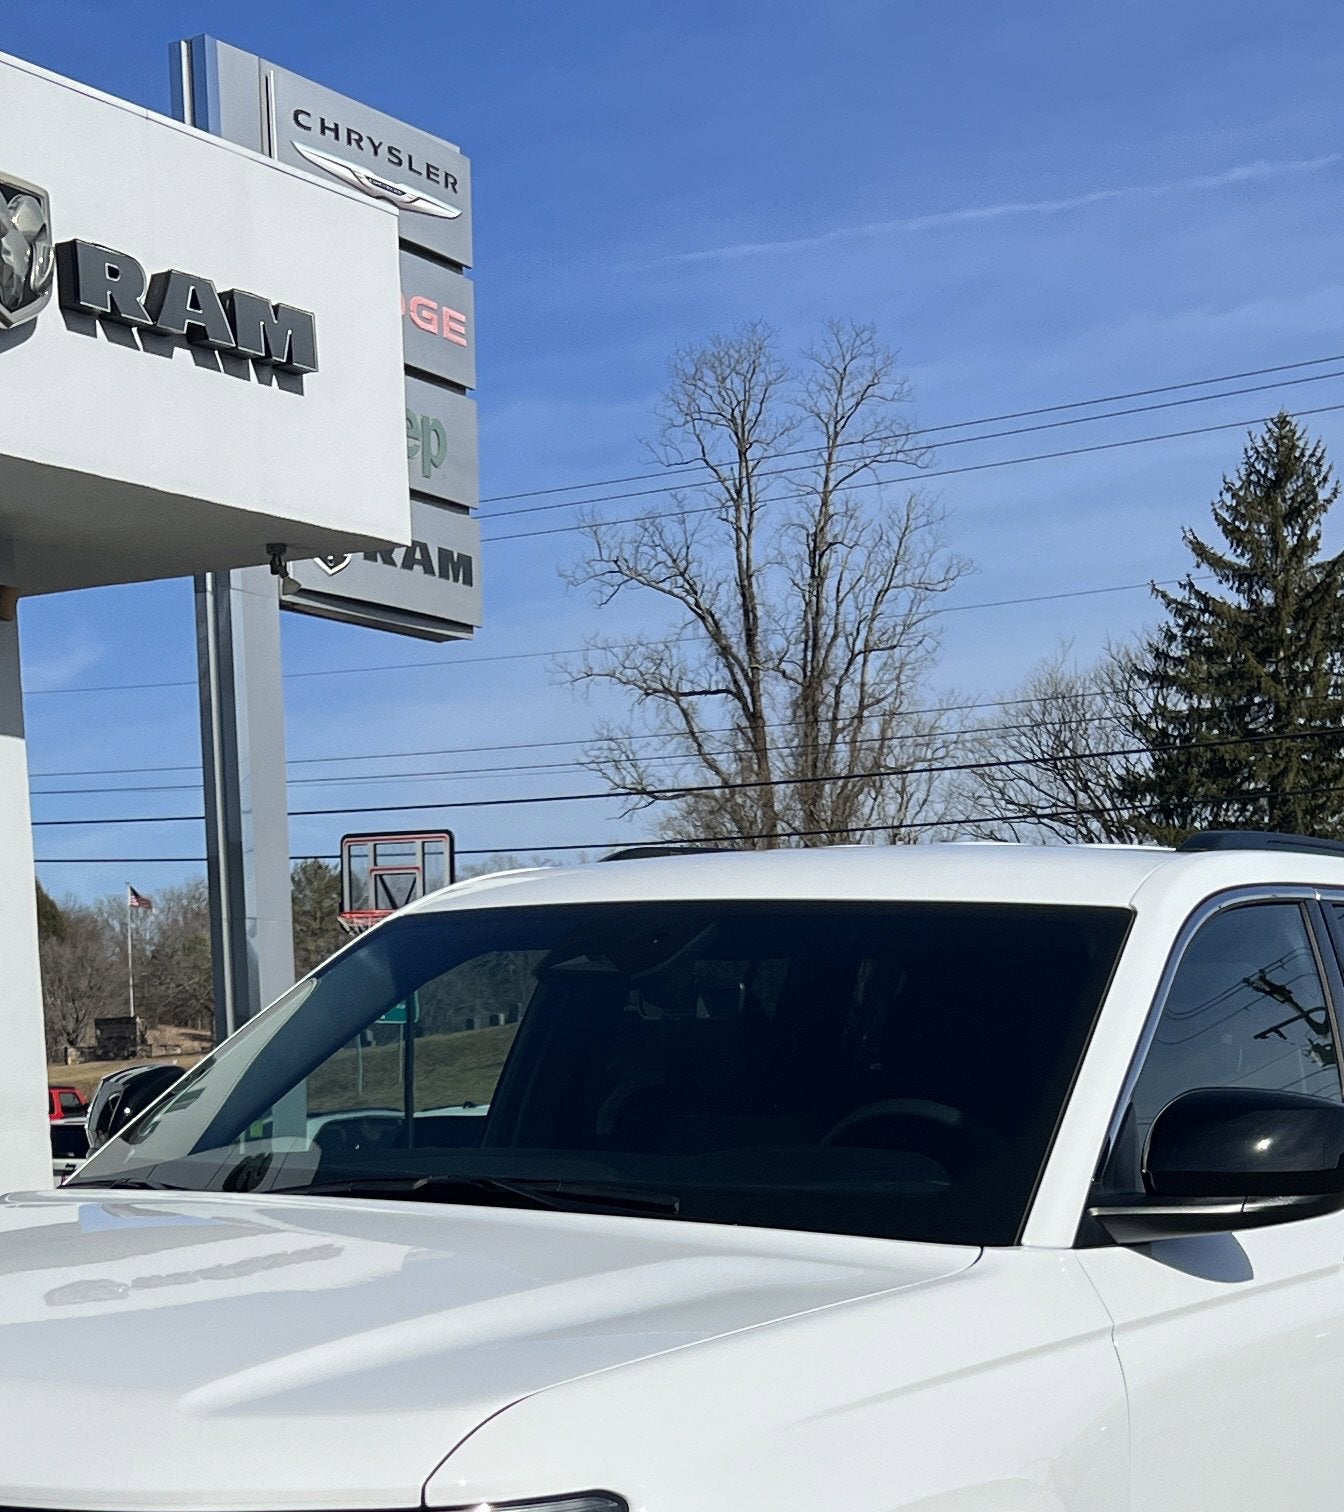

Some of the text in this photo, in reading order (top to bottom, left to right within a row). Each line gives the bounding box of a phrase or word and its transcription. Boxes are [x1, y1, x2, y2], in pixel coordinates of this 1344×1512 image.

[292, 108, 459, 194] CHRYSLER
[56, 239, 319, 373] RAM
[401, 292, 468, 347] GE
